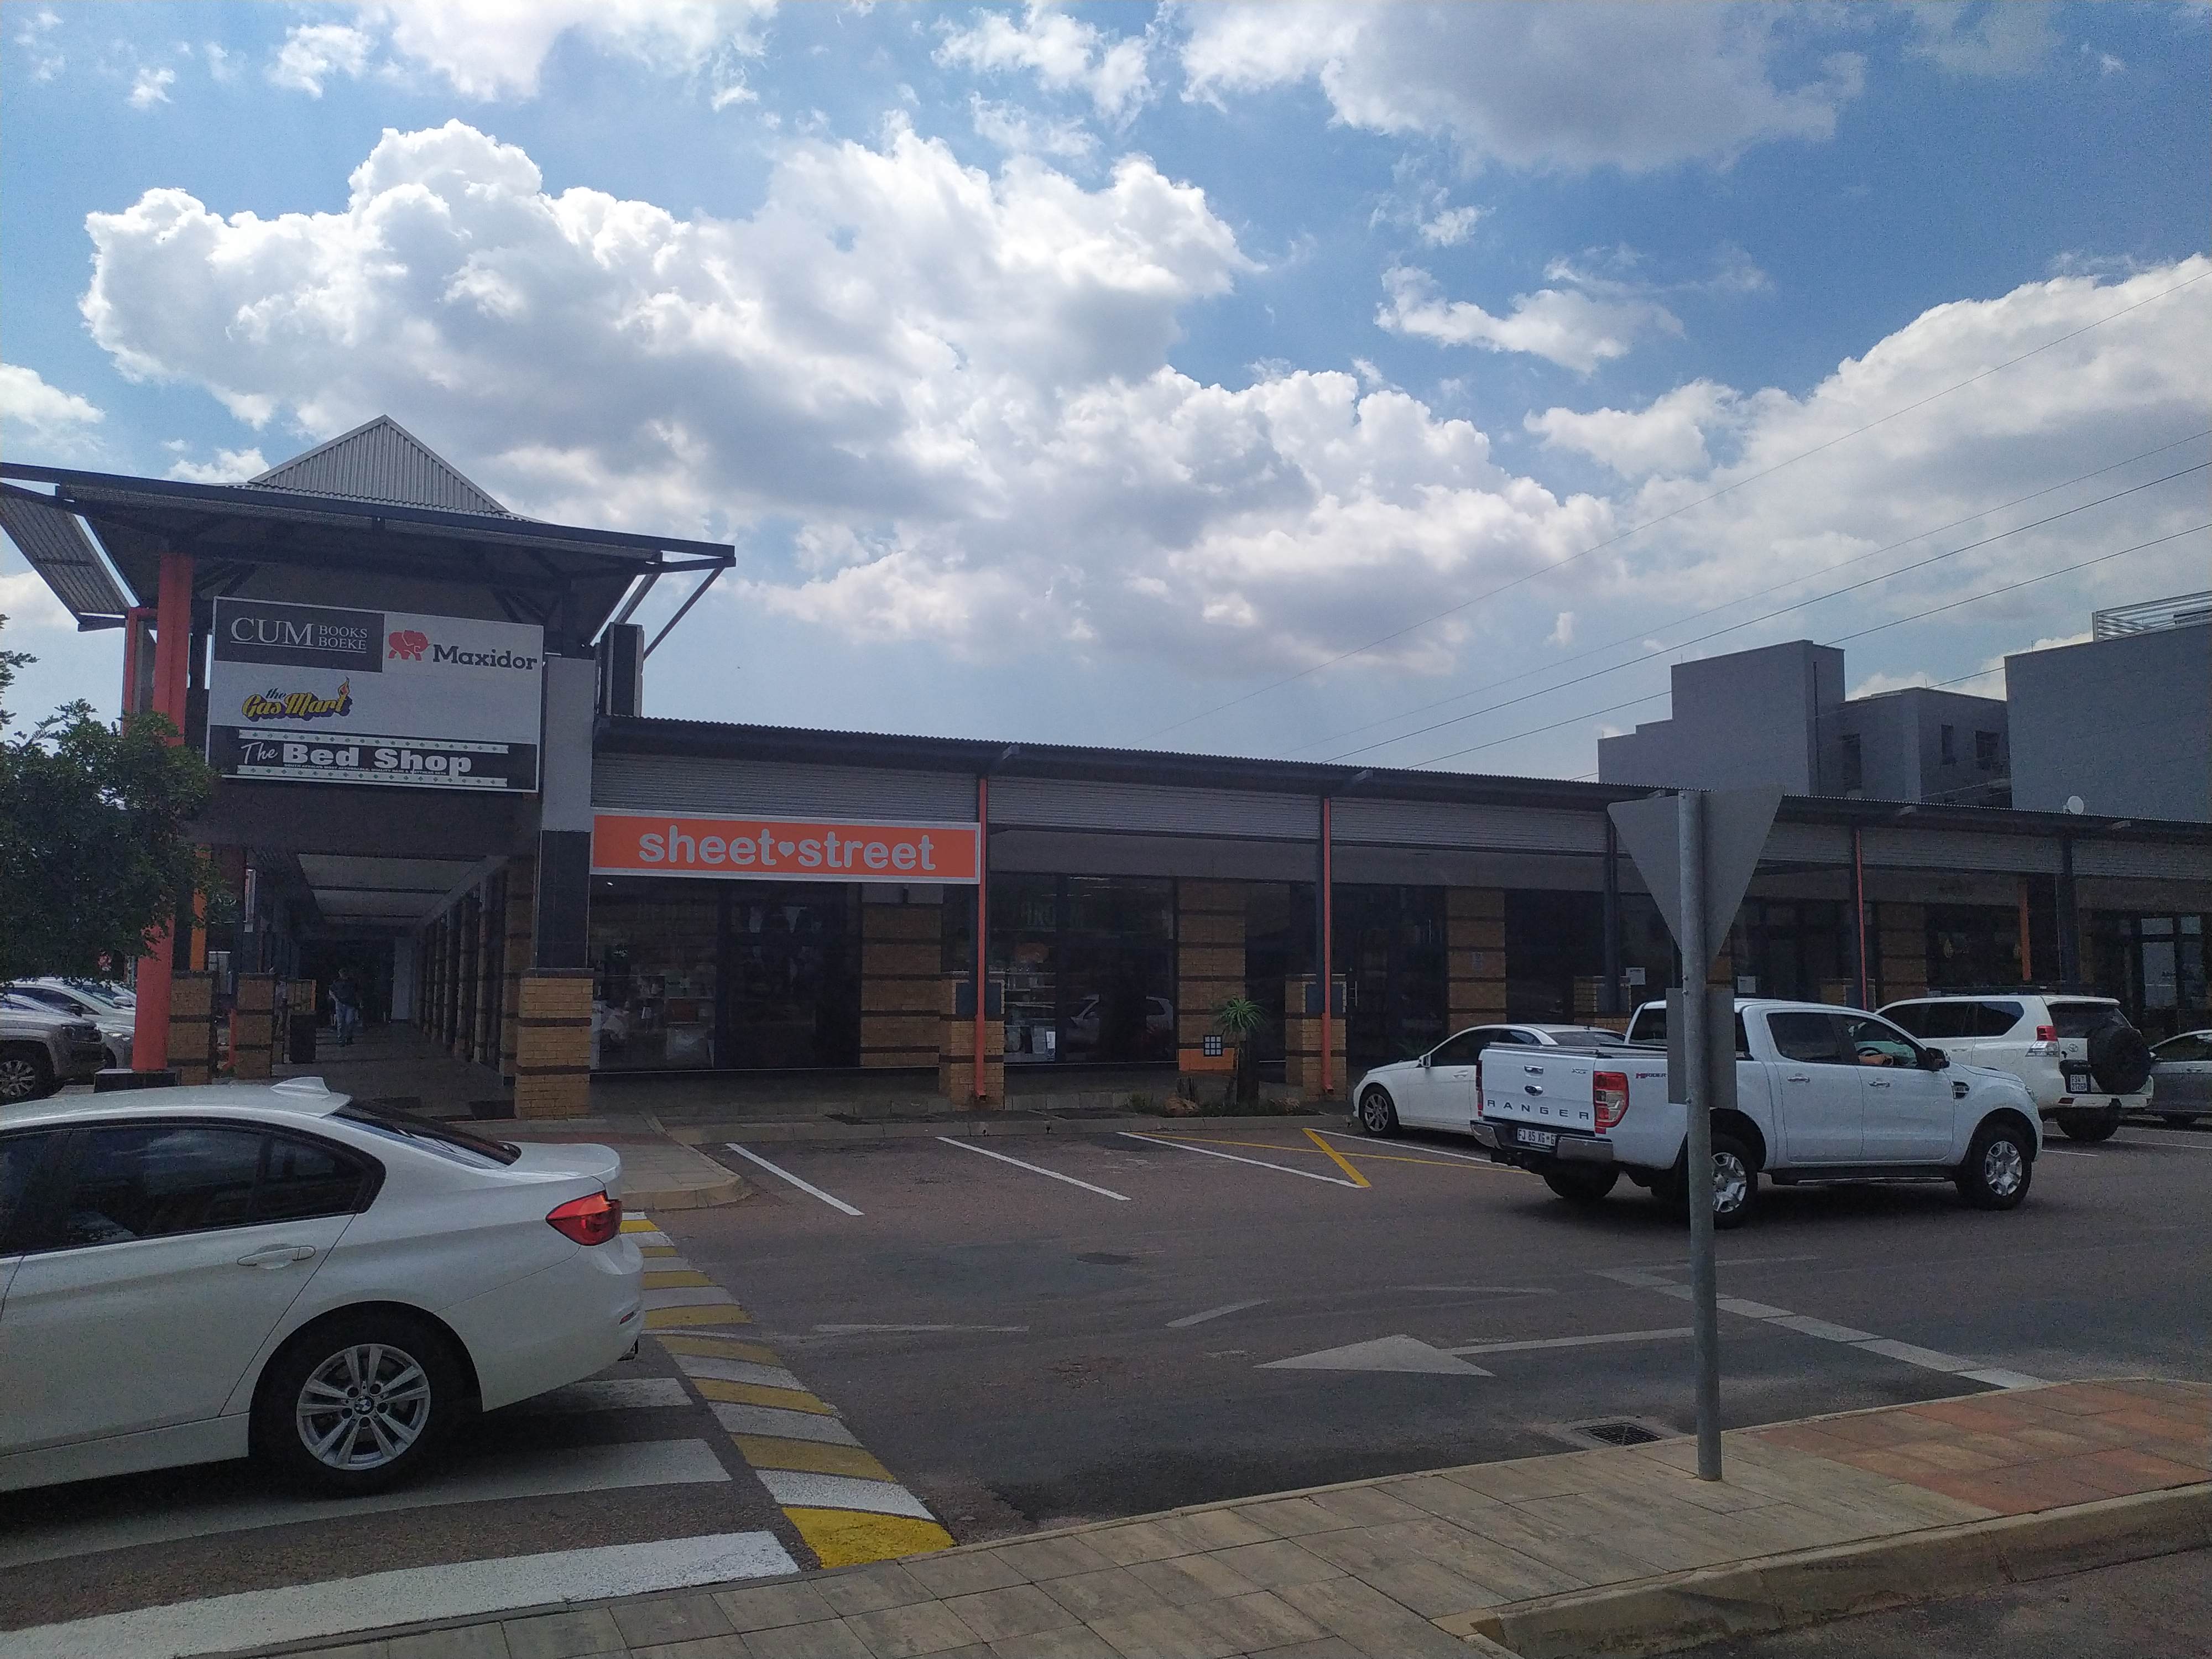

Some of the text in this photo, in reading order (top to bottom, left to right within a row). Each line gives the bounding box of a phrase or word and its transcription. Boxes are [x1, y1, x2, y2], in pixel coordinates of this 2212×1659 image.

[230, 617, 368, 646] CUM BOOKS
[318, 637, 367, 650] BOEKE
[433, 644, 538, 670] Maxidor
[265, 687, 286, 700] the
[241, 741, 472, 775] The Bed Shop
[1488, 1099, 1589, 1120] RANGER
[1518, 1130, 1526, 1140] FJ
[1528, 1131, 1536, 1141] 85
